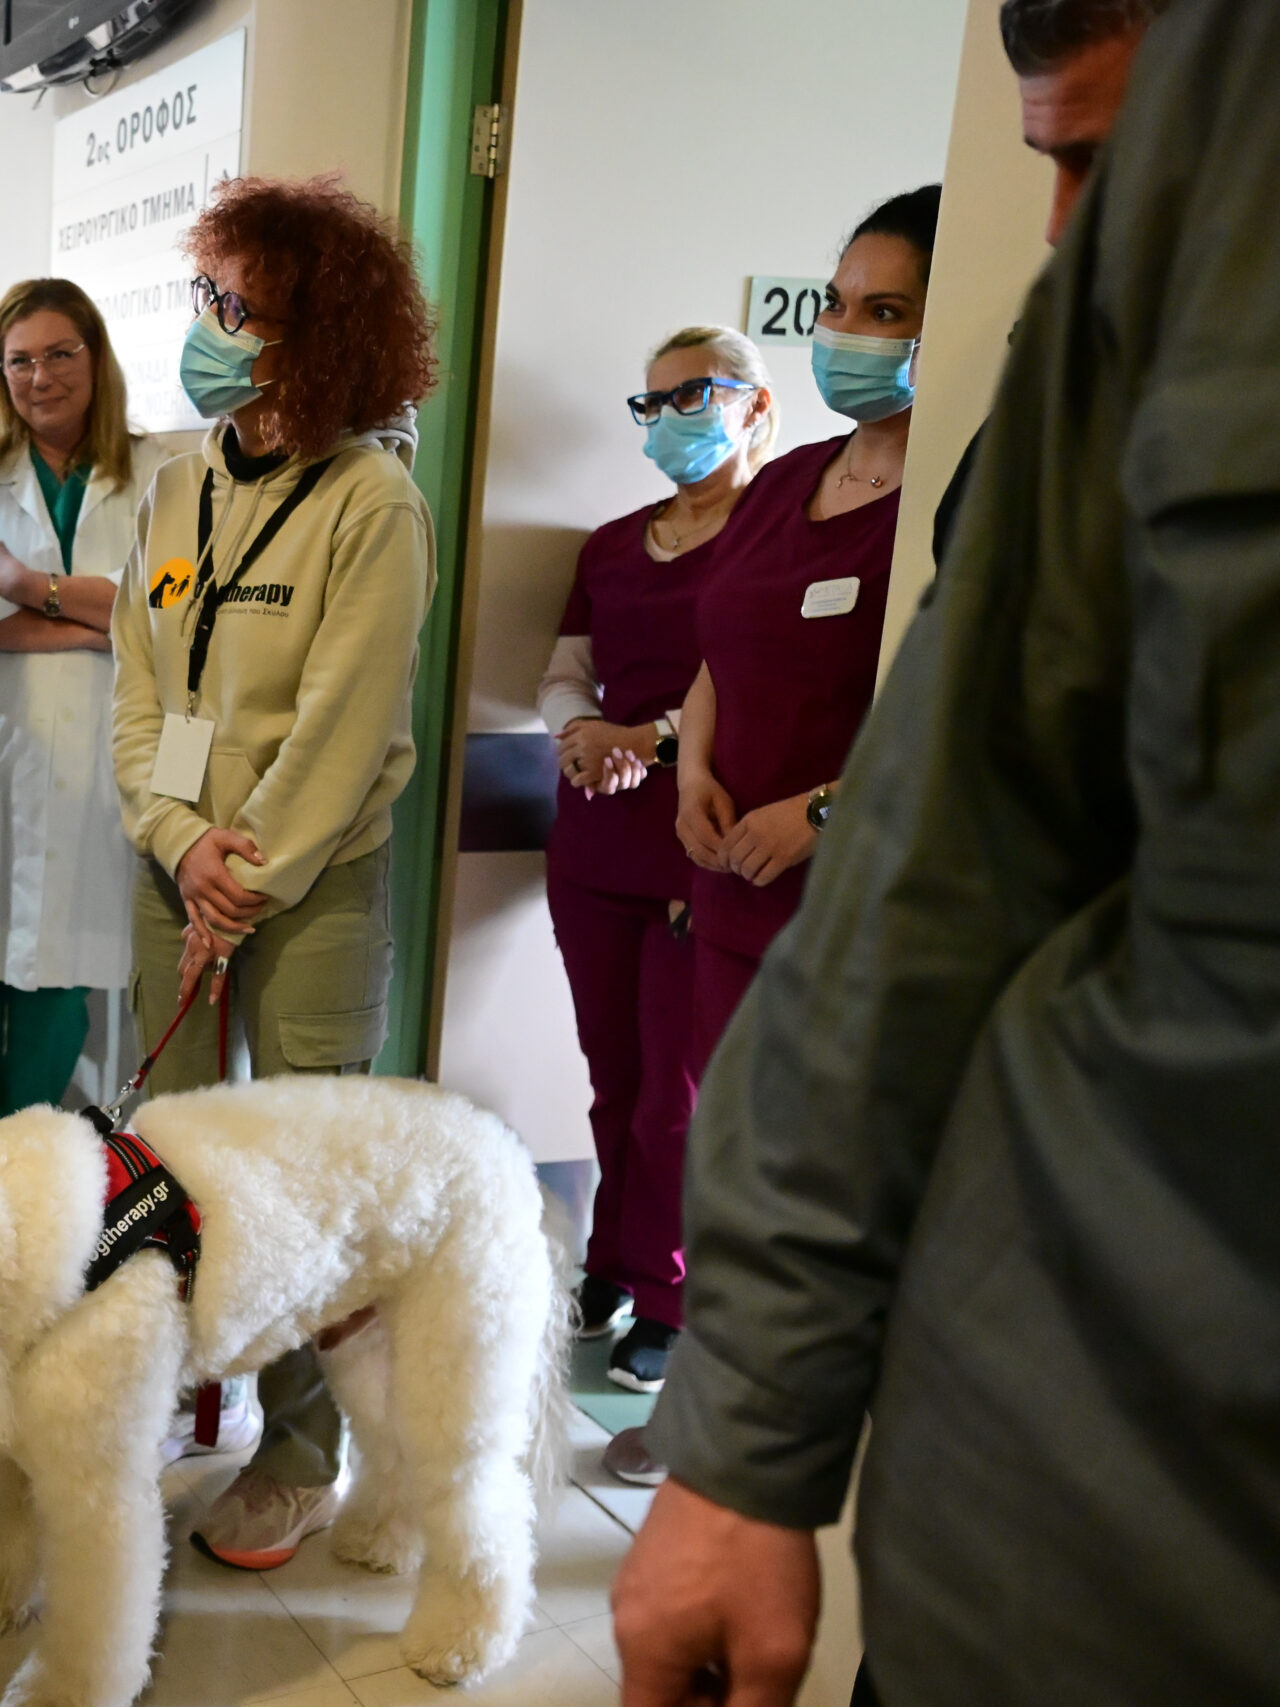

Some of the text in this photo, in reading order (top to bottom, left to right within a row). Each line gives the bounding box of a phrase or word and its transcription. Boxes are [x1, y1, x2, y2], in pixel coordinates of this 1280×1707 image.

[86, 84, 197, 168] 2ος ΟΡΟΦΟΣ
[58, 182, 196, 253] ΧΕΙΡΟΥΡΓΙΚΟ ΤΜΗΜΑ
[762, 287, 821, 336] 20
